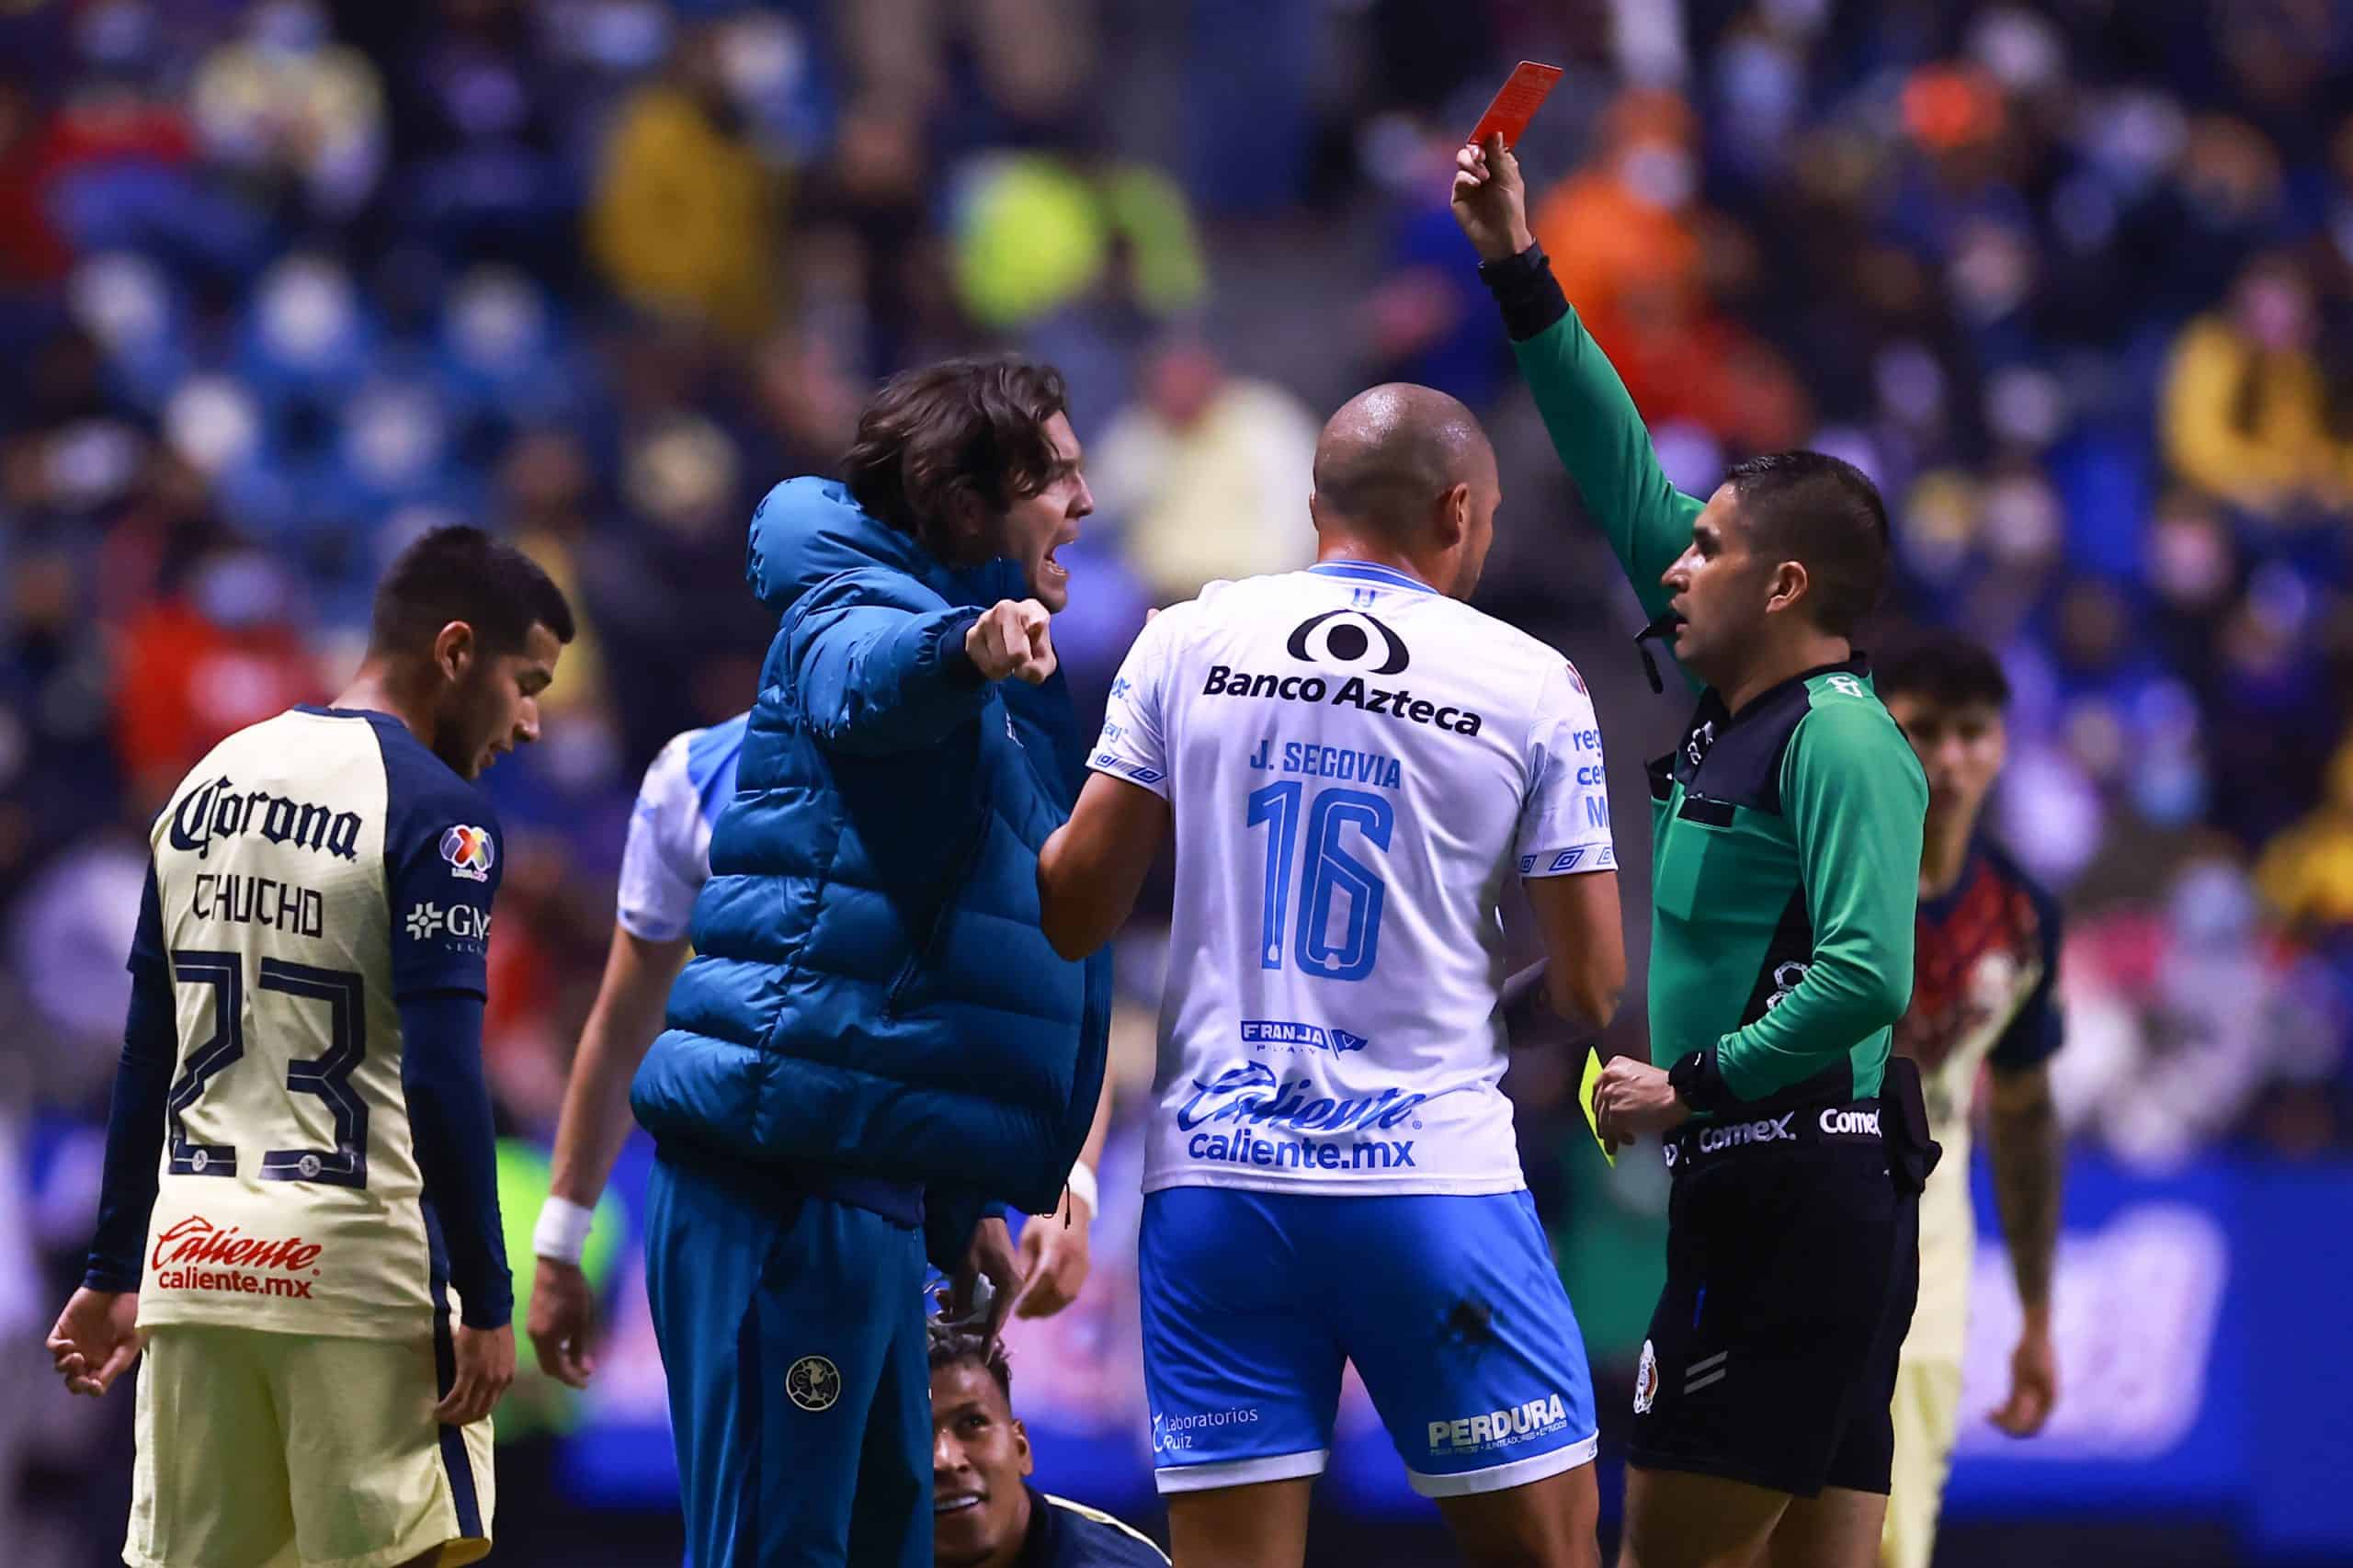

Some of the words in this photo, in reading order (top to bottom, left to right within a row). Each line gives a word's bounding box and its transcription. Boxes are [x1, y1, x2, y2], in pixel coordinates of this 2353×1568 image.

[1202, 665, 1326, 704] Banco
[1331, 676, 1483, 738] Azteca
[1248, 739, 1276, 772] J.
[1285, 742, 1401, 790] SEGOVIA
[168, 775, 362, 859] Corona
[192, 873, 324, 939] CHUCHO
[1246, 780, 1394, 983] 16
[1243, 1024, 1324, 1047] FRANJA
[167, 949, 368, 1189] 23
[1177, 1060, 1427, 1131] Caliente
[1188, 1129, 1416, 1169] caliente.mx
[152, 1215, 322, 1271] Caliente
[158, 1267, 313, 1300] caliente.mx
[1163, 1434, 1192, 1449] Ruiz
[1165, 1407, 1258, 1432] Laboratorios
[1428, 1393, 1566, 1449] PERDURA
